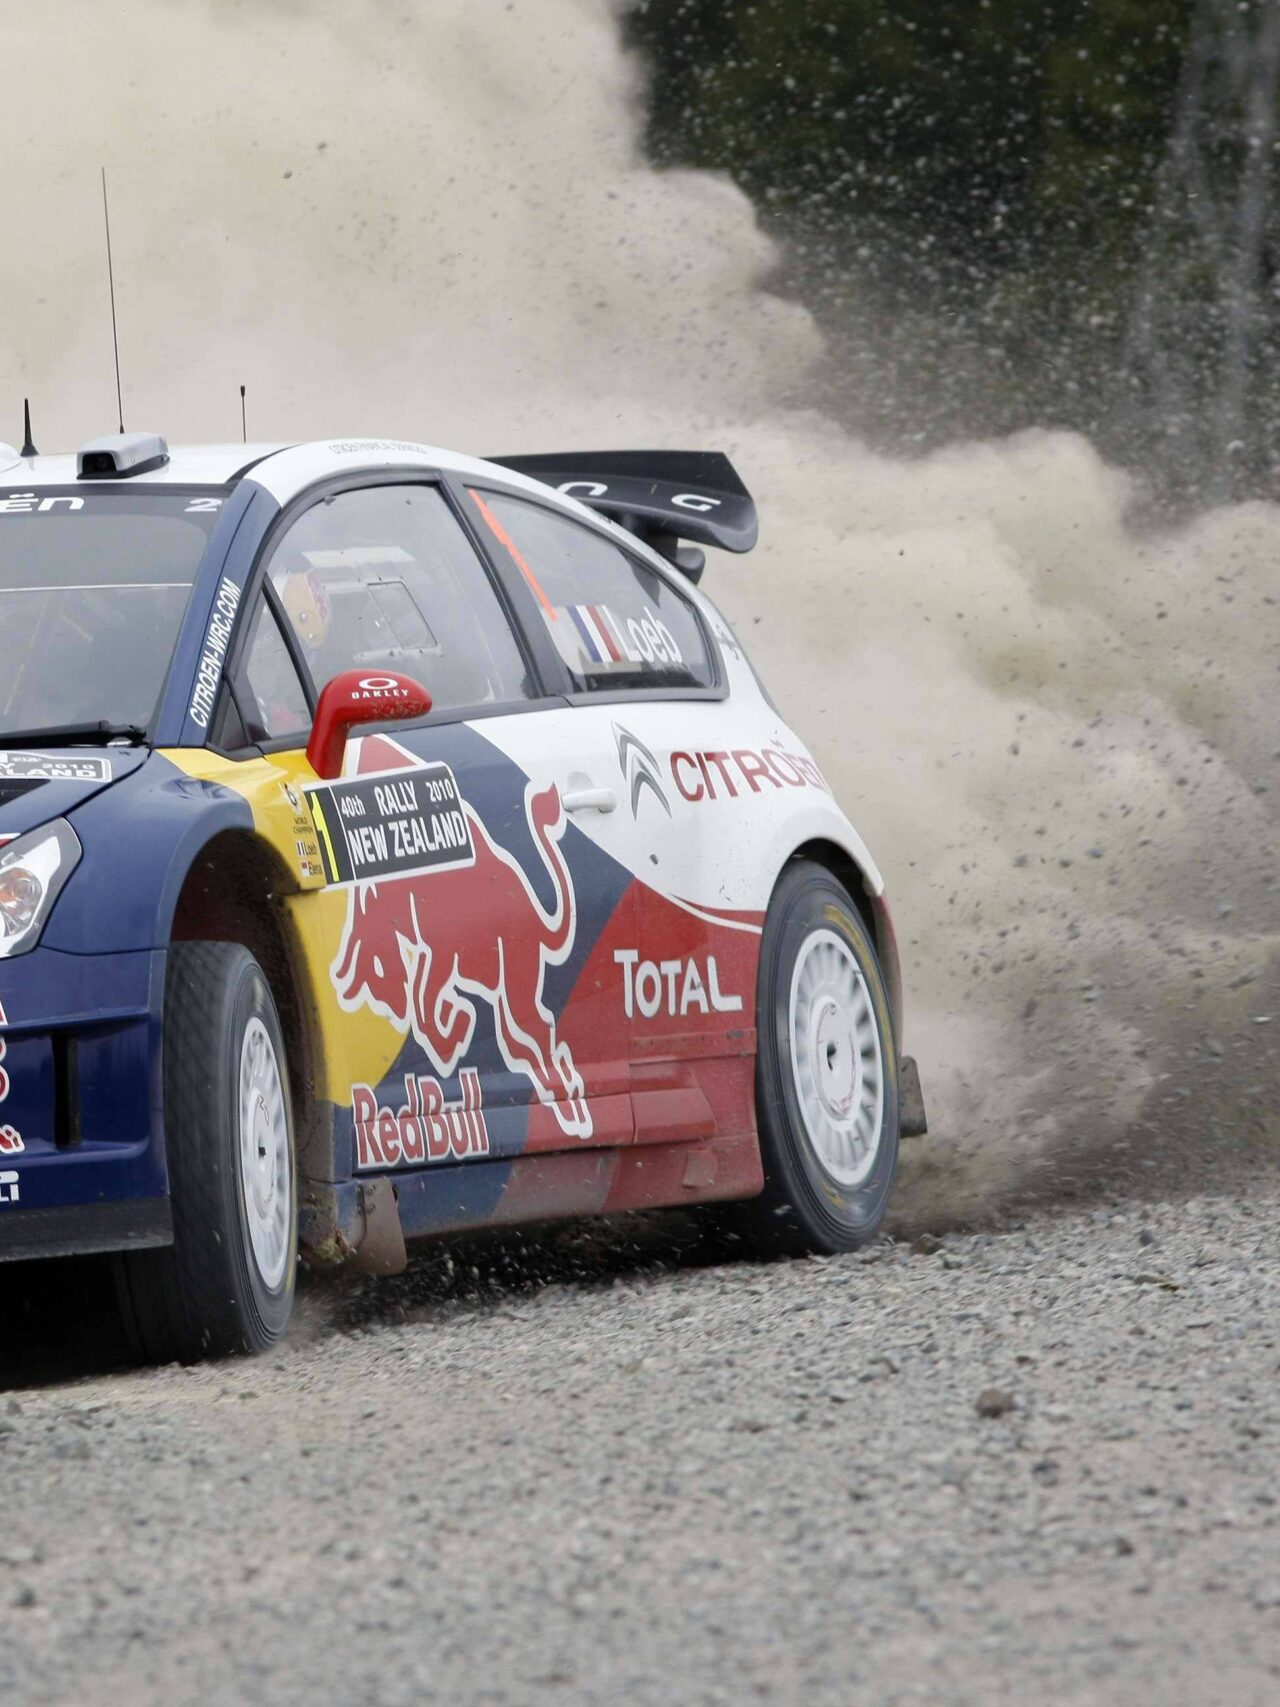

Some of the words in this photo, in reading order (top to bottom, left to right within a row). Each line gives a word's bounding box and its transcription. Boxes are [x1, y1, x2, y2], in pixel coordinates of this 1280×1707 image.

[184, 498, 222, 512] 2
[190, 577, 241, 728] CITROEN-WRC.COM
[602, 604, 682, 663] Loeb
[352, 689, 408, 699] OAKLEY
[340, 794, 366, 818] 40th
[374, 780, 418, 816] RALLY
[425, 778, 455, 803] 2010
[348, 823, 388, 865] NEW
[388, 810, 468, 858] ZEALAND
[613, 949, 743, 1019] TOTAL
[352, 1072, 425, 1169] Red
[417, 1066, 490, 1160] Bull
